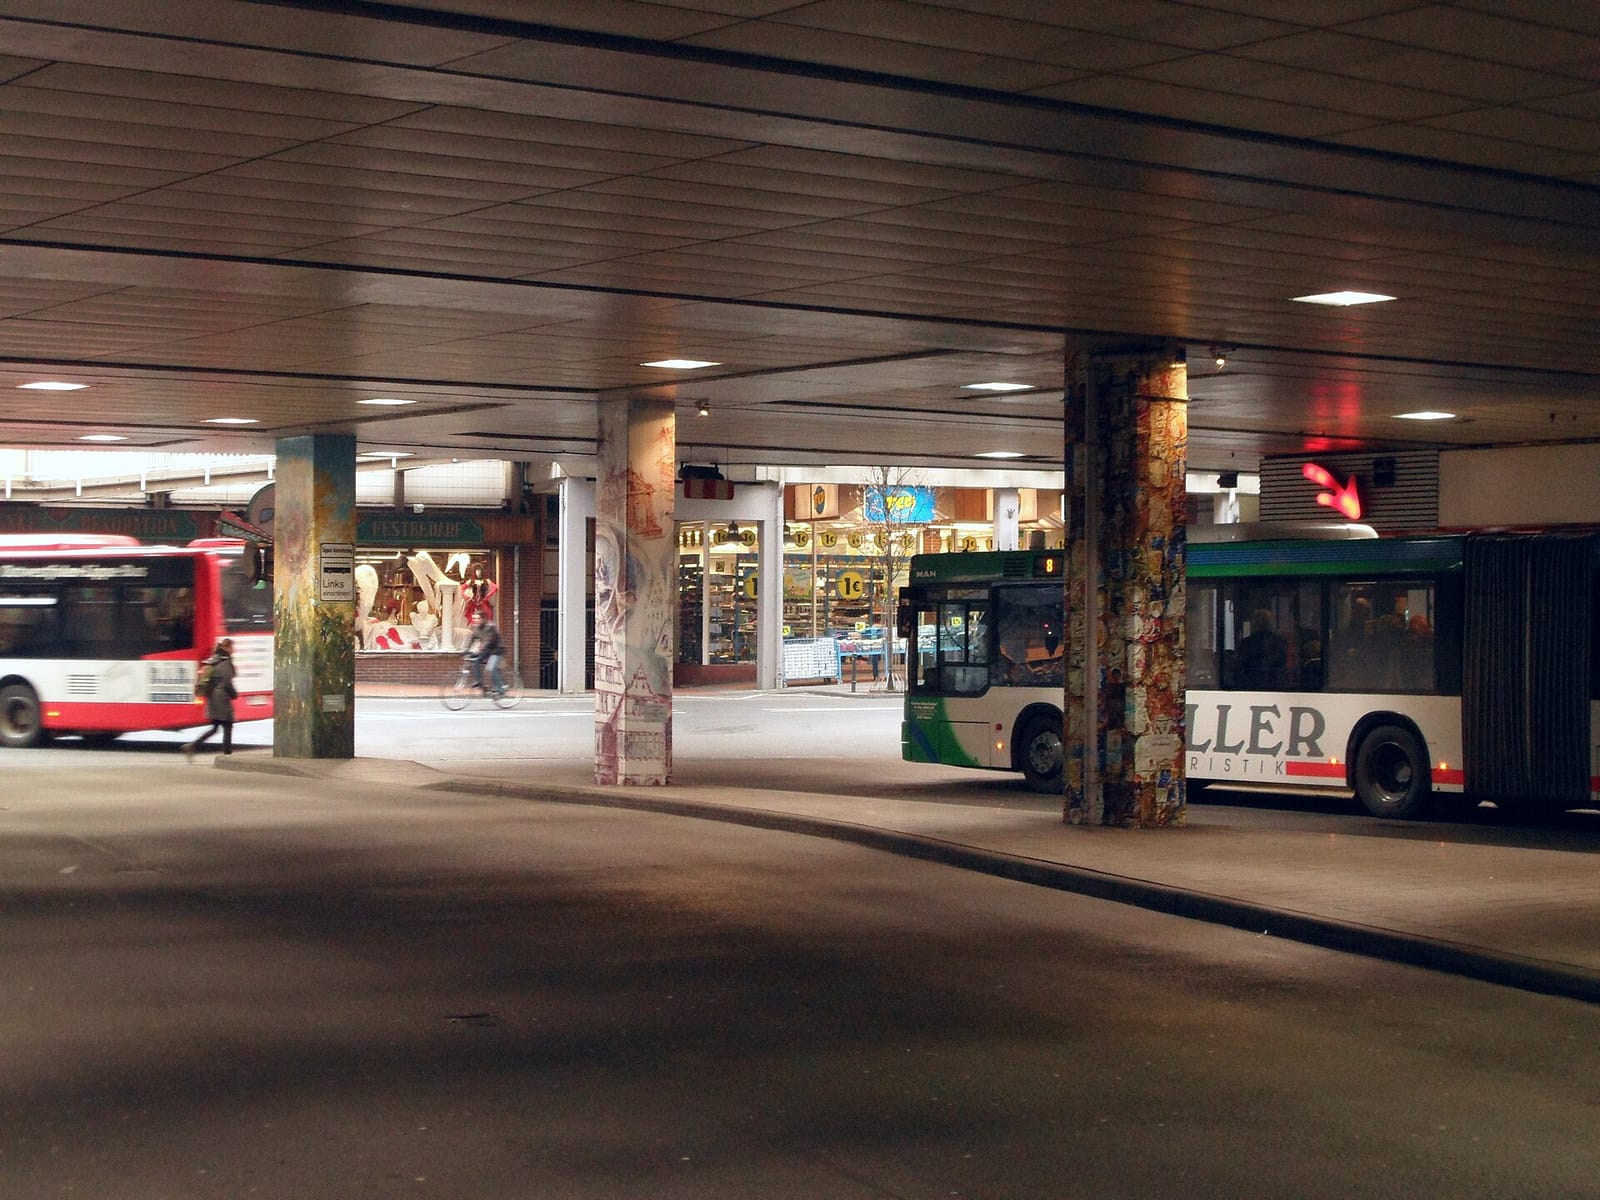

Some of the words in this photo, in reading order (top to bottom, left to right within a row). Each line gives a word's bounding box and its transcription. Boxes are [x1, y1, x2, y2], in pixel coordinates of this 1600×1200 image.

[372, 520, 462, 536] FESTBEDARF
[1046, 558, 1054, 573] 8
[916, 570, 936, 578] MAN
[323, 579, 345, 590] Links
[1186, 704, 1325, 758] LLER
[1190, 757, 1284, 775] RISTIK
